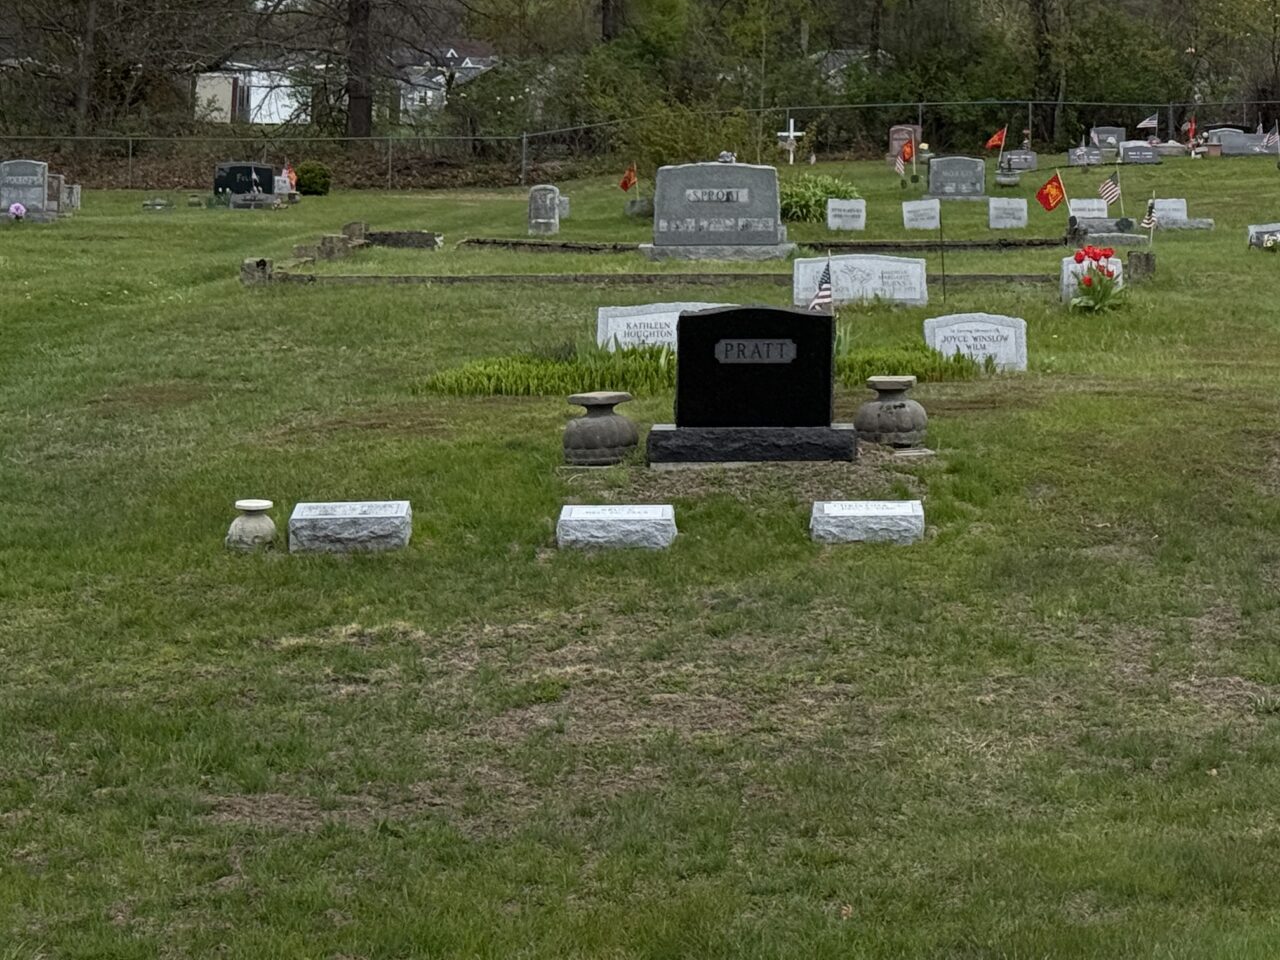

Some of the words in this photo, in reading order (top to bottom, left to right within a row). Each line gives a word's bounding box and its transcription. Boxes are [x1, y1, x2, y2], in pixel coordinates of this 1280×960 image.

[625, 322, 671, 330] KATHLEEN
[623, 330, 673, 338] HOUGHTON
[941, 335, 968, 343] JOYCE
[971, 335, 1010, 343] WINSLOW
[723, 342, 789, 360] PRATT
